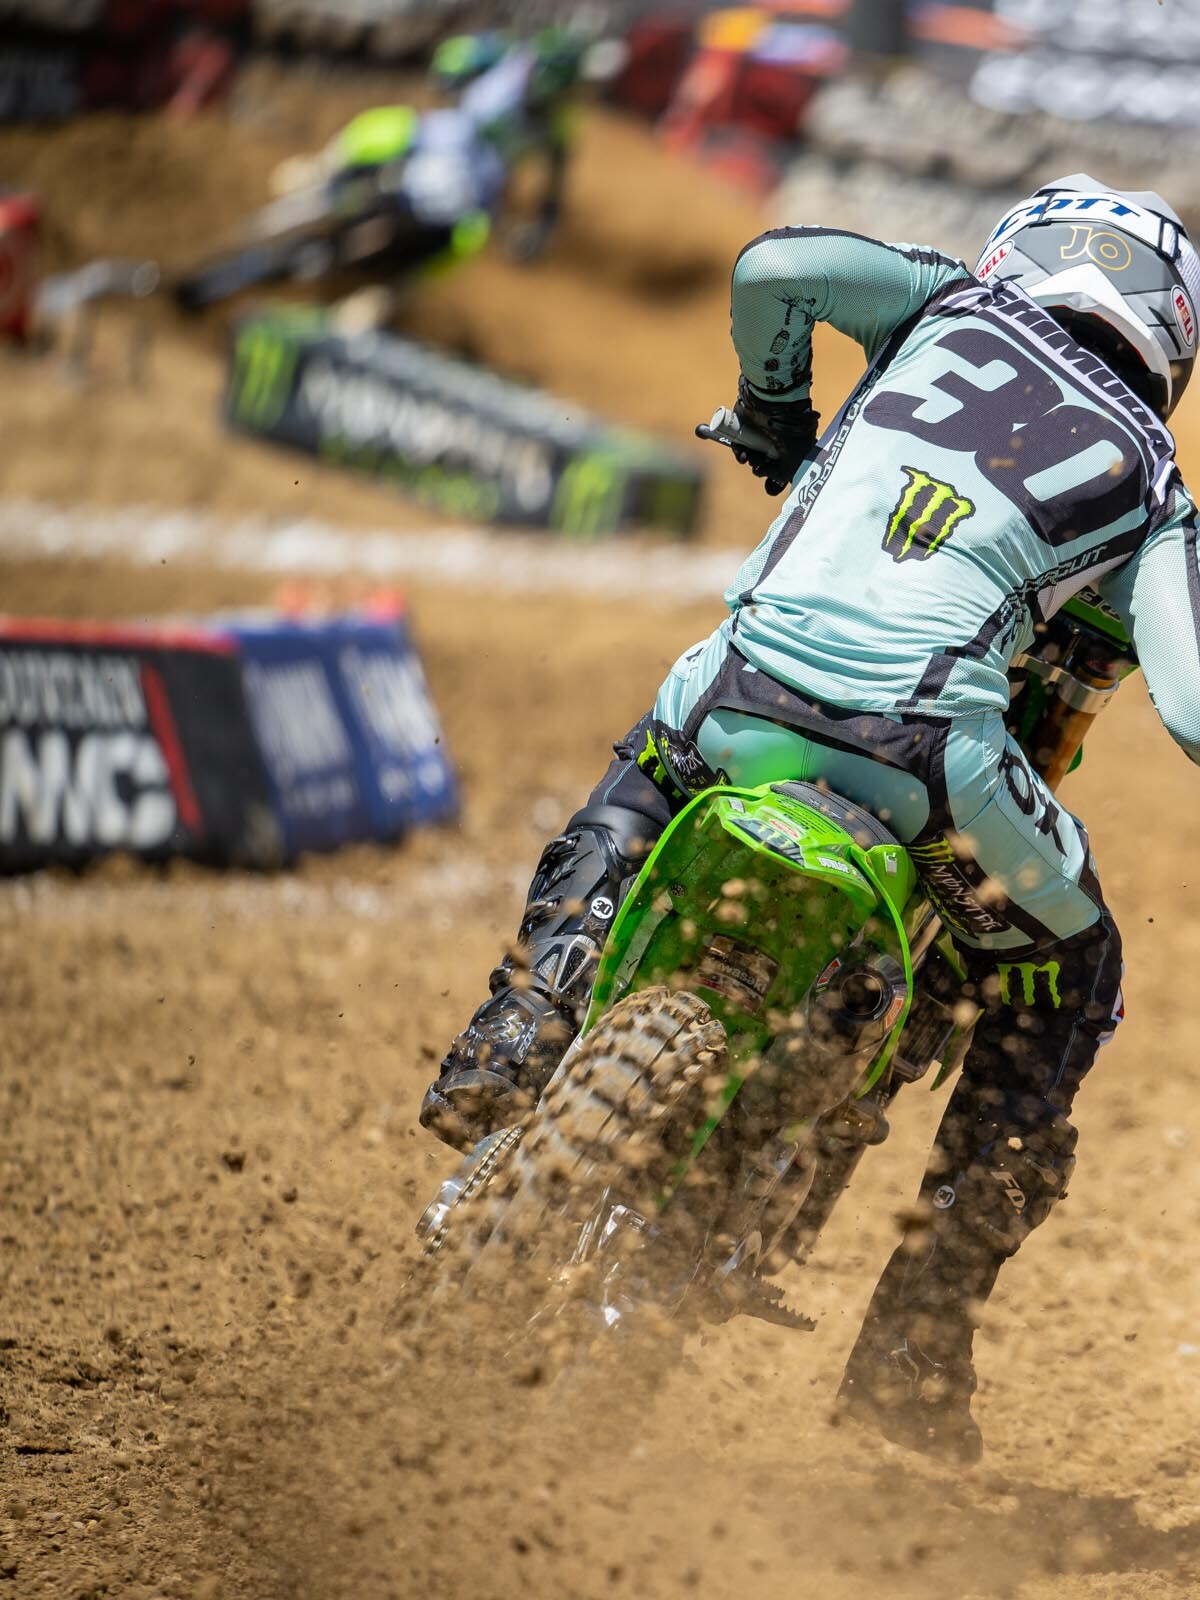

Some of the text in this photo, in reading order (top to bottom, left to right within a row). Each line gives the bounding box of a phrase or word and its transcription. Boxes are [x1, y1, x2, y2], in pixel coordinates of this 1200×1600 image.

[987, 198, 1141, 244] COTT
[1061, 226, 1132, 271] JO
[1175, 294, 1194, 342] BELL
[863, 328, 1150, 546] 30
[1000, 747, 1068, 858] OX
[593, 899, 612, 916] 30
[713, 960, 768, 994] wasaki
